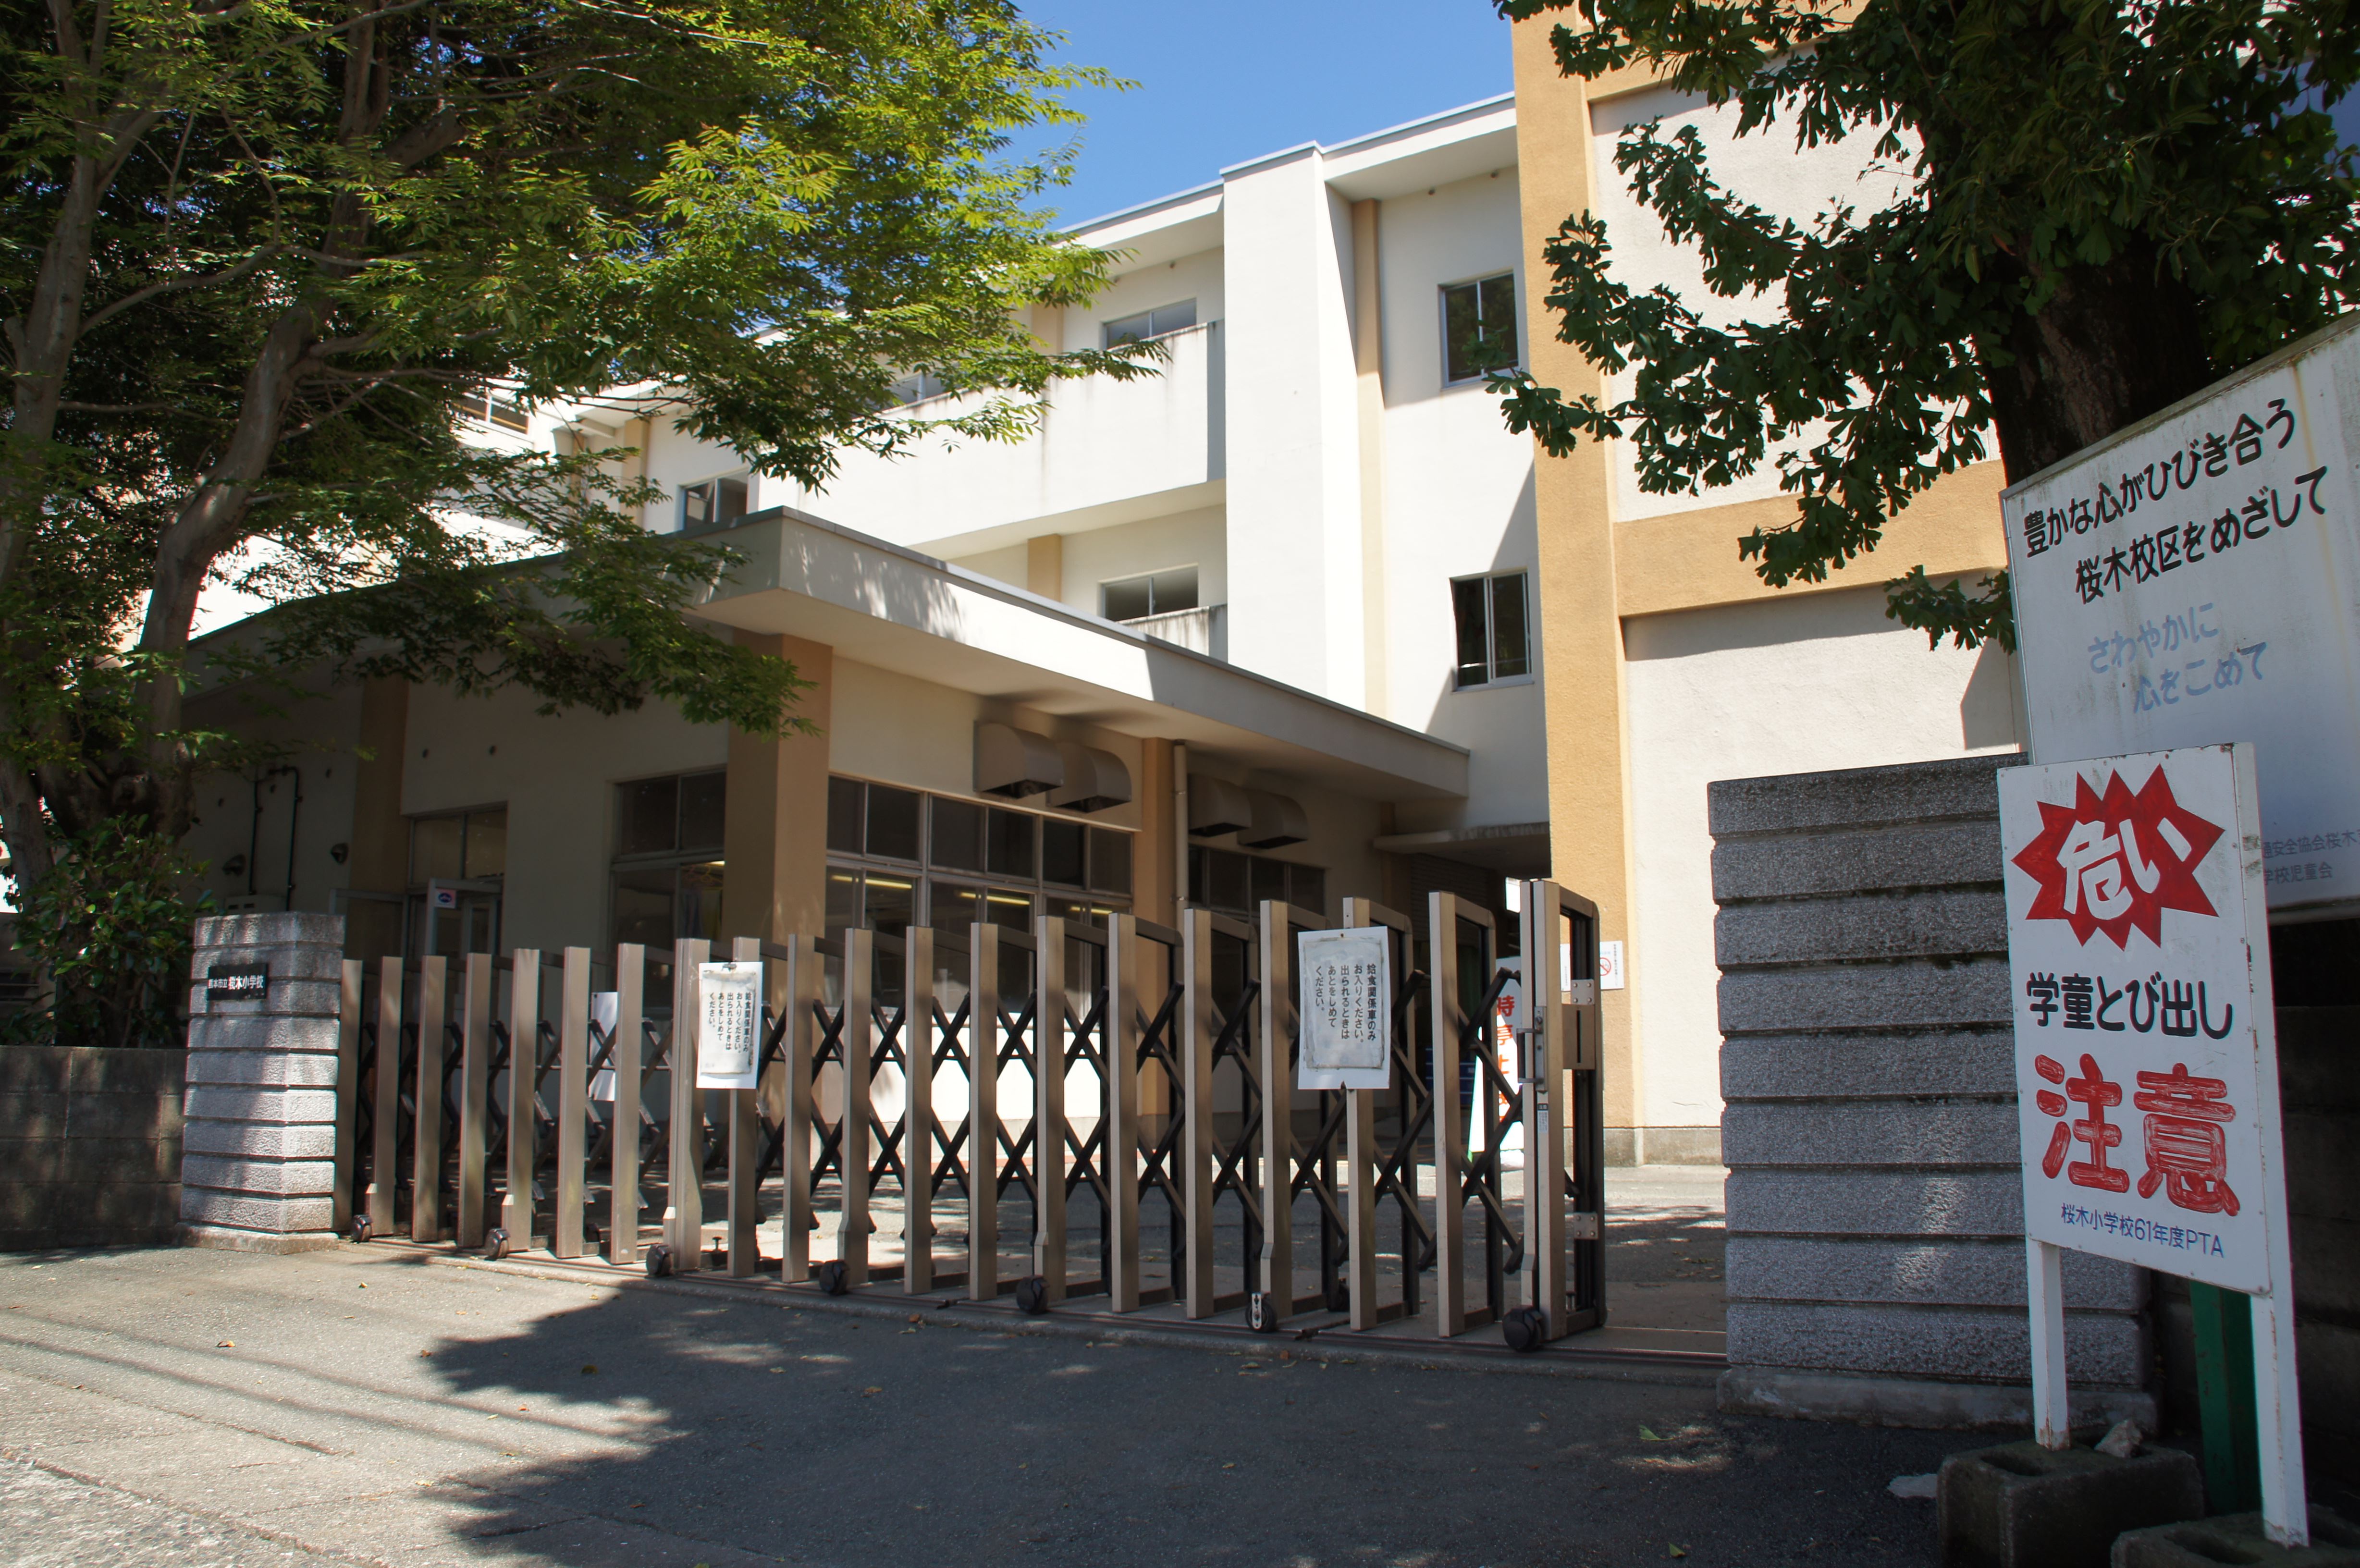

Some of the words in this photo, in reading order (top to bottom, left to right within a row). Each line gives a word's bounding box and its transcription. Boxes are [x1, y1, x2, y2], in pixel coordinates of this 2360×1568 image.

[2023, 398, 2296, 557] 豊かな心がひびき合う
[2076, 466, 2327, 604] 桜木校区をめざして
[2088, 603, 2219, 673] さわやかに
[2133, 642, 2267, 713] 心をこめて
[2056, 817, 2192, 920] 危い
[1328, 965, 1337, 1028] あとをしめて
[1341, 965, 1350, 1040] 出られるときは
[1367, 963, 1377, 1041] 給食関係車のみ
[2026, 971, 2233, 1039] 学童とび出し
[2034, 1053, 2240, 1216] 注意
